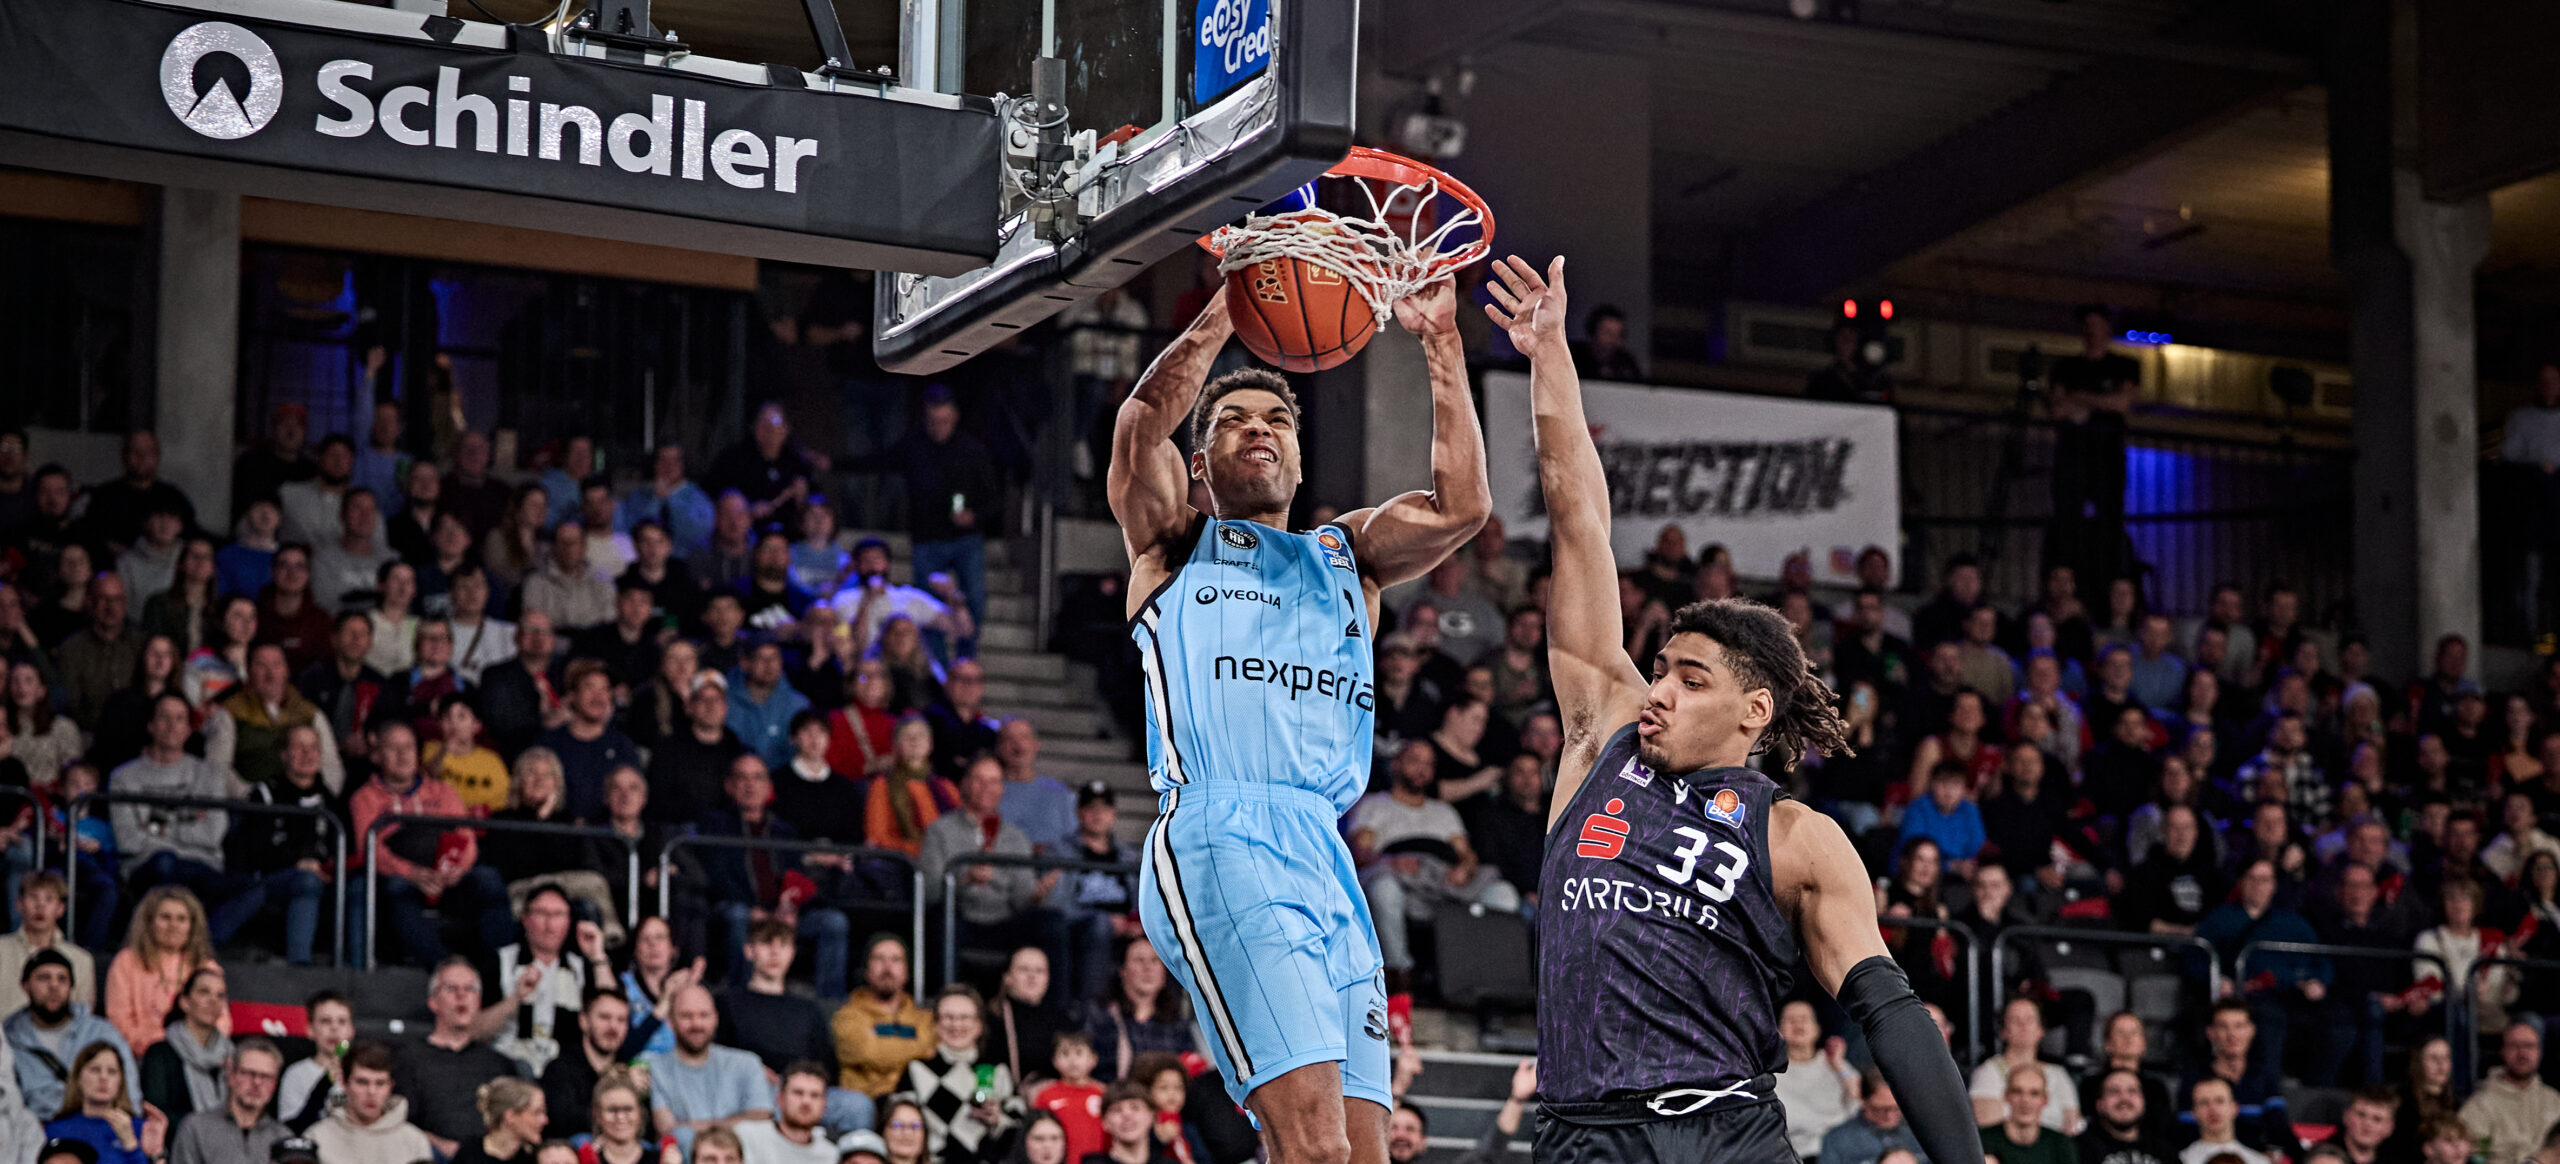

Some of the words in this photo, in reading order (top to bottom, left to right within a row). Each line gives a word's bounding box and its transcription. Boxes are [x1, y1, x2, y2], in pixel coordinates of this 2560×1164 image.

[314, 60, 818, 194] Schindler
[1213, 558, 1251, 568] CRAFT
[1329, 556, 1354, 570] BBL
[1221, 588, 1282, 610] VEOLIA
[1215, 655, 1375, 713] nexperia
[1621, 771, 1648, 786] GÖTTINGEN
[1708, 804, 1737, 824] BBL
[1656, 826, 1749, 903] 33
